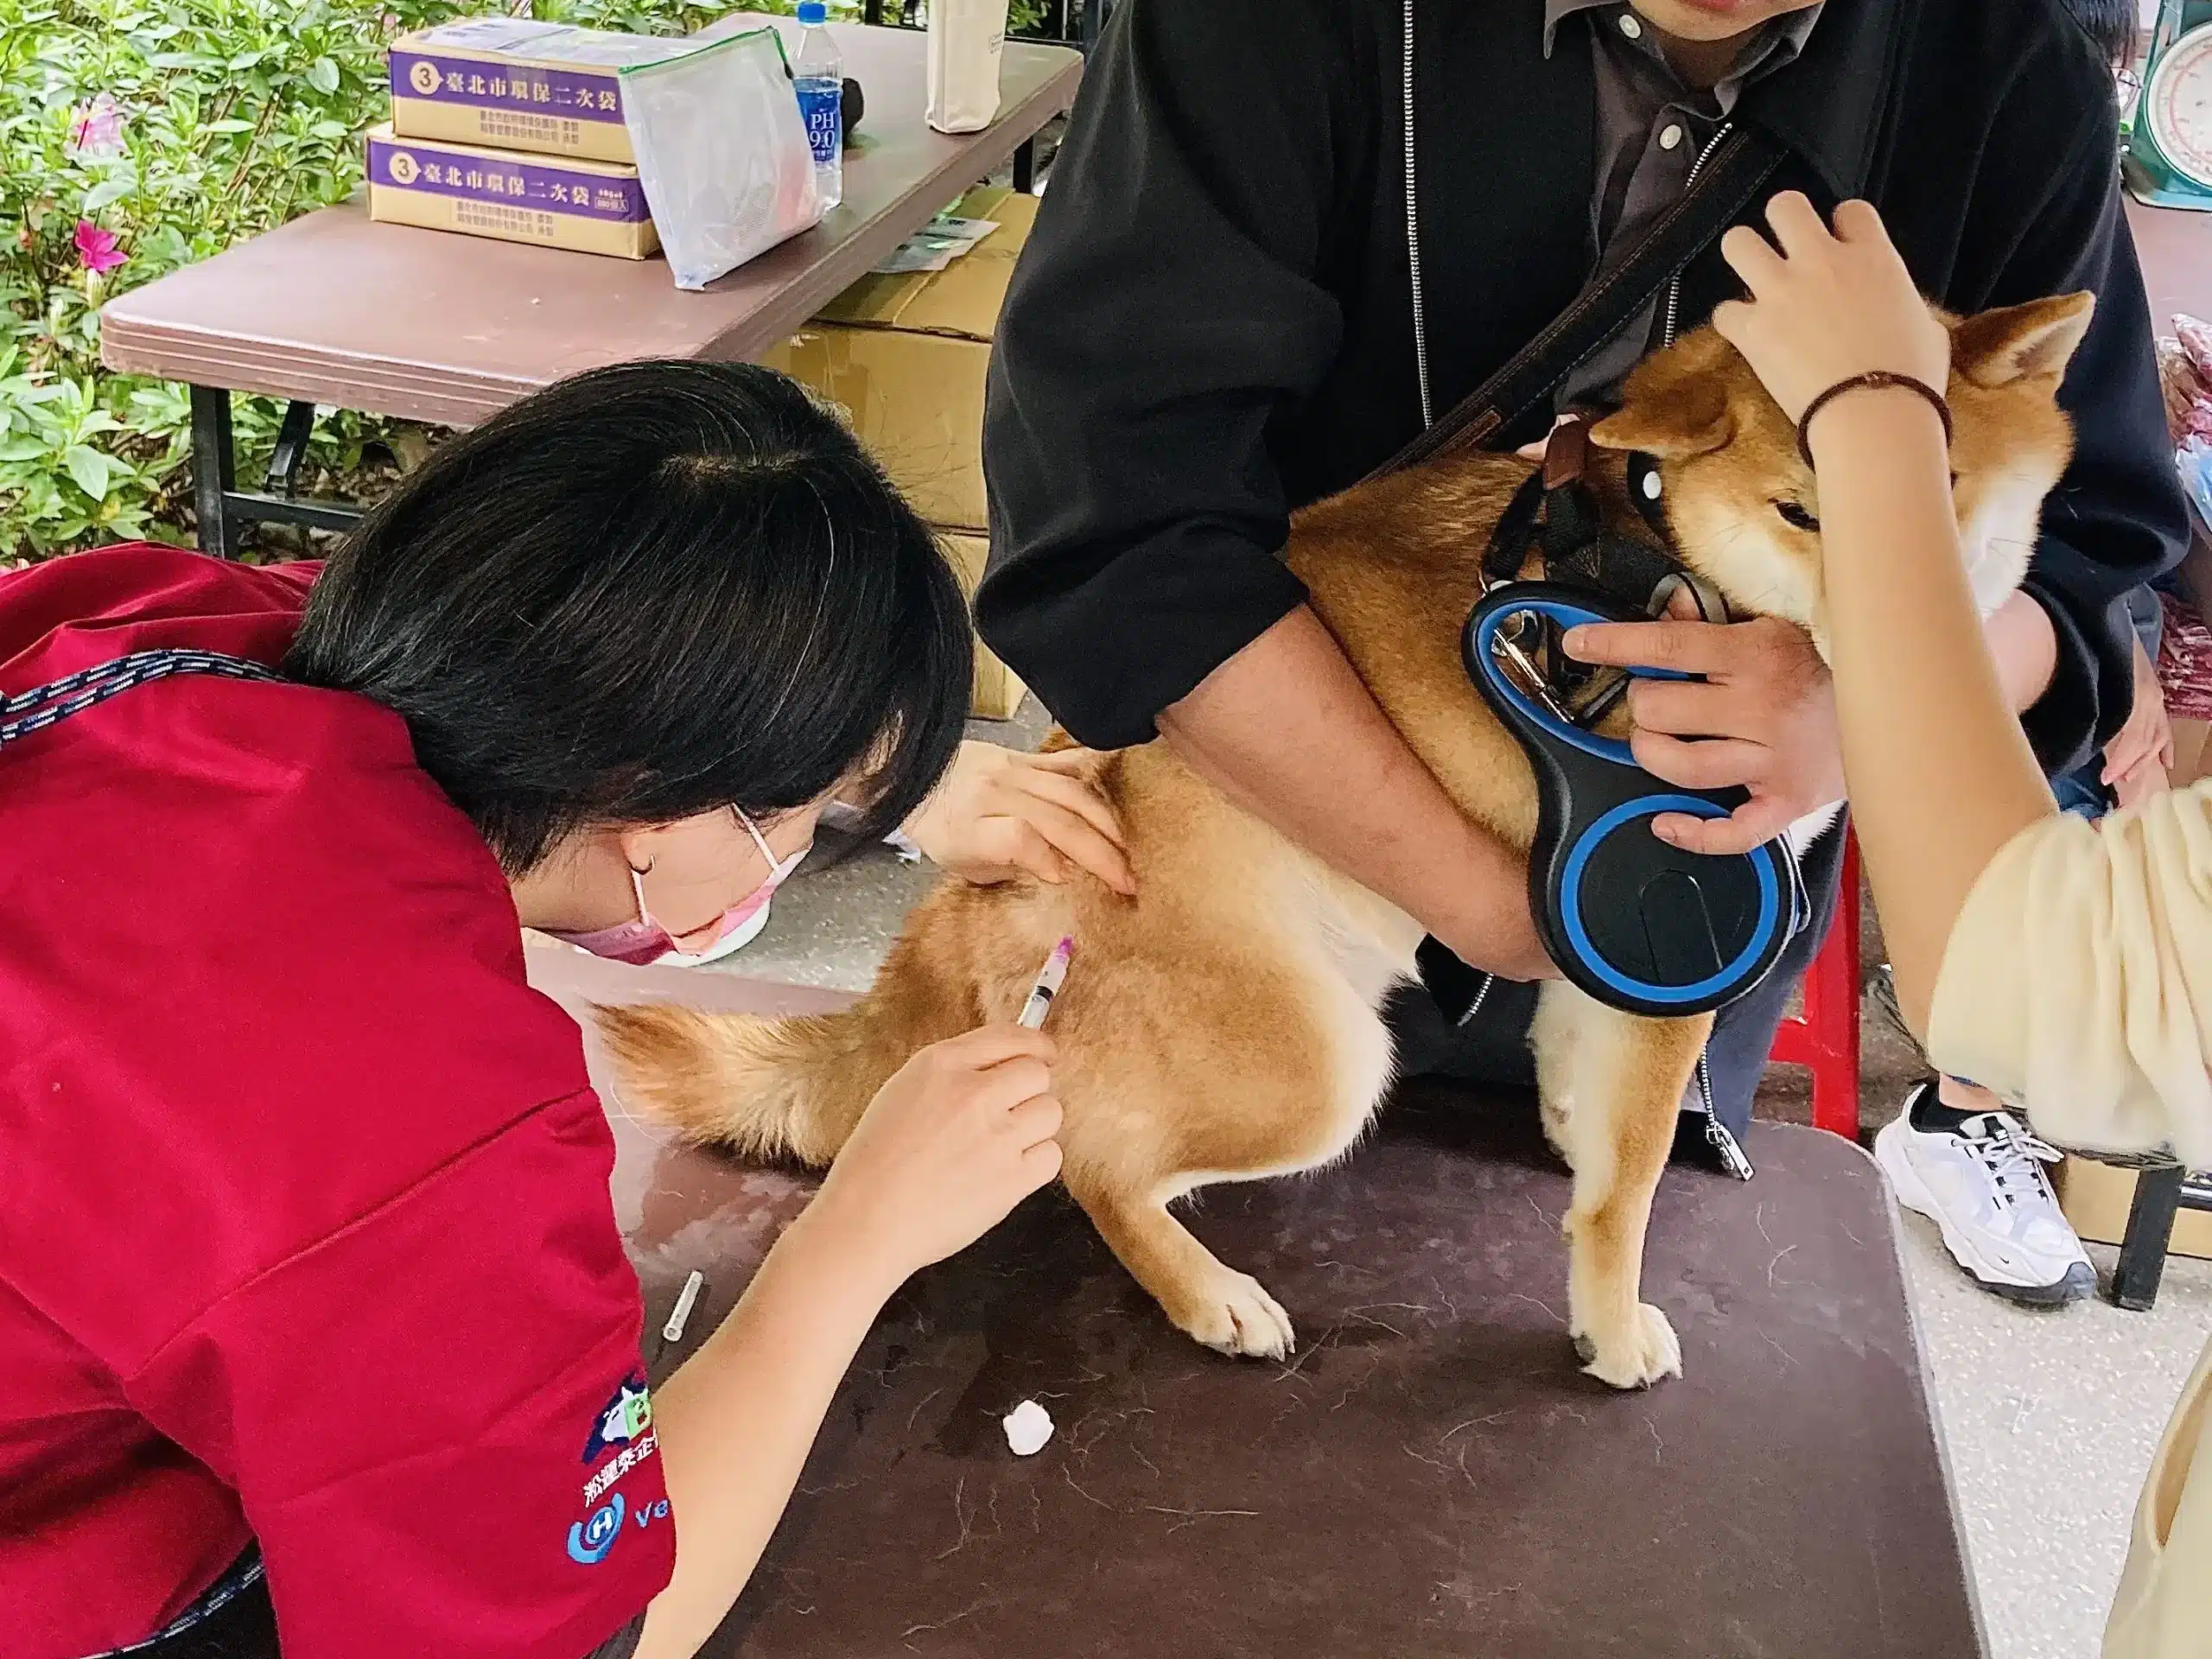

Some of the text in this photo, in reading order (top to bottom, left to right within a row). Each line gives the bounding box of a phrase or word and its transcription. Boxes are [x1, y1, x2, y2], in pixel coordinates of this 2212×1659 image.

[418, 67, 432, 87] 3
[810, 112, 835, 130] PH
[809, 130, 836, 149] 9.0
[397, 158, 410, 177] 3
